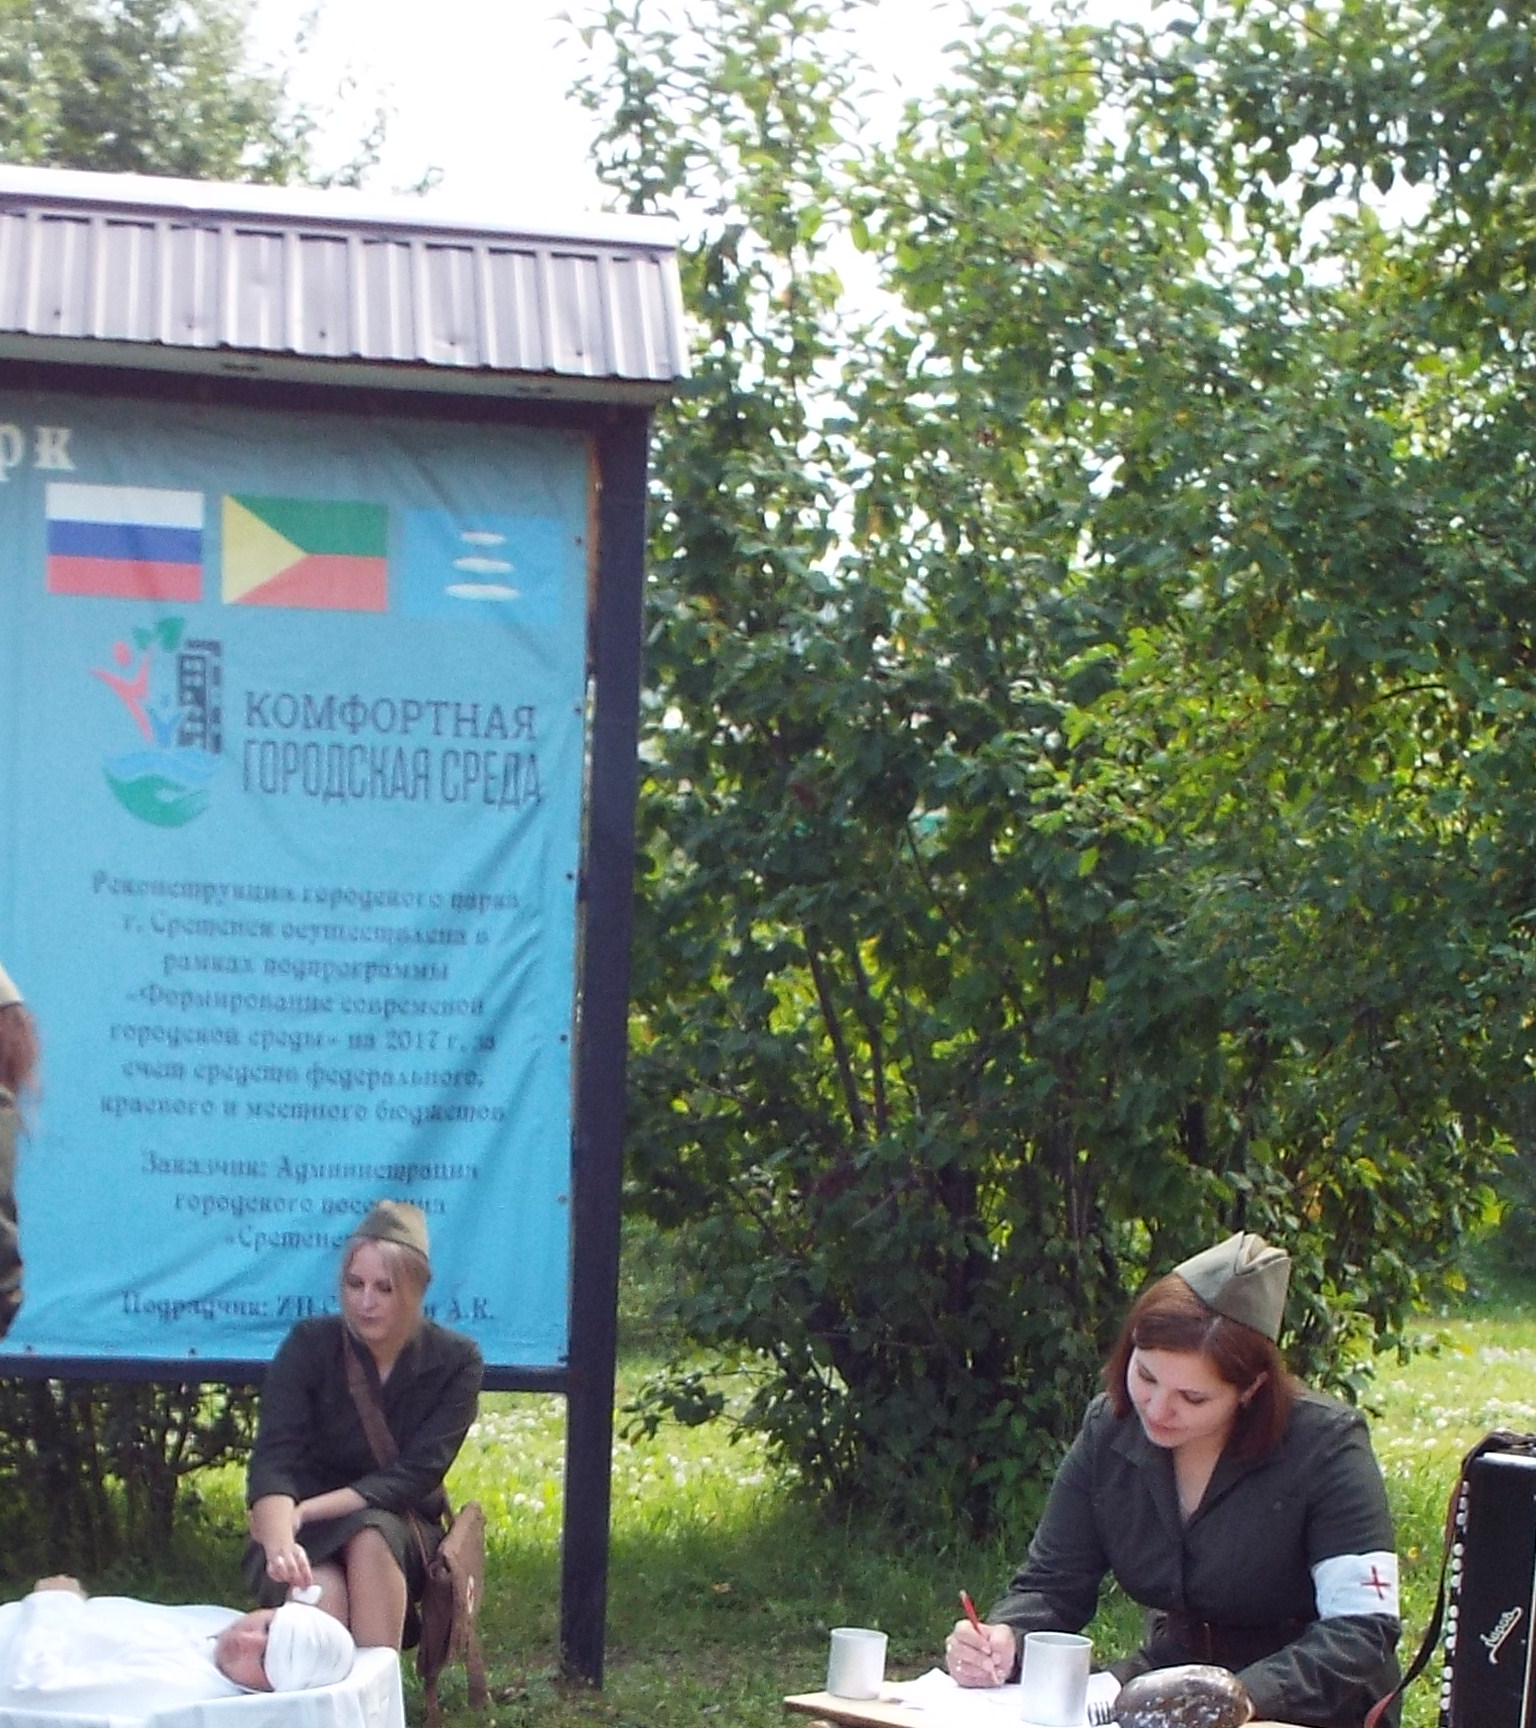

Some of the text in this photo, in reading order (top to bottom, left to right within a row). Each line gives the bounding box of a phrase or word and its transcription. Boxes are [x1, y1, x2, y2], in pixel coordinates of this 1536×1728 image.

[244, 690, 538, 741] КОМФОРТНАЯ
[242, 738, 544, 808] ГОРОДСКАЯ СРЕДА
